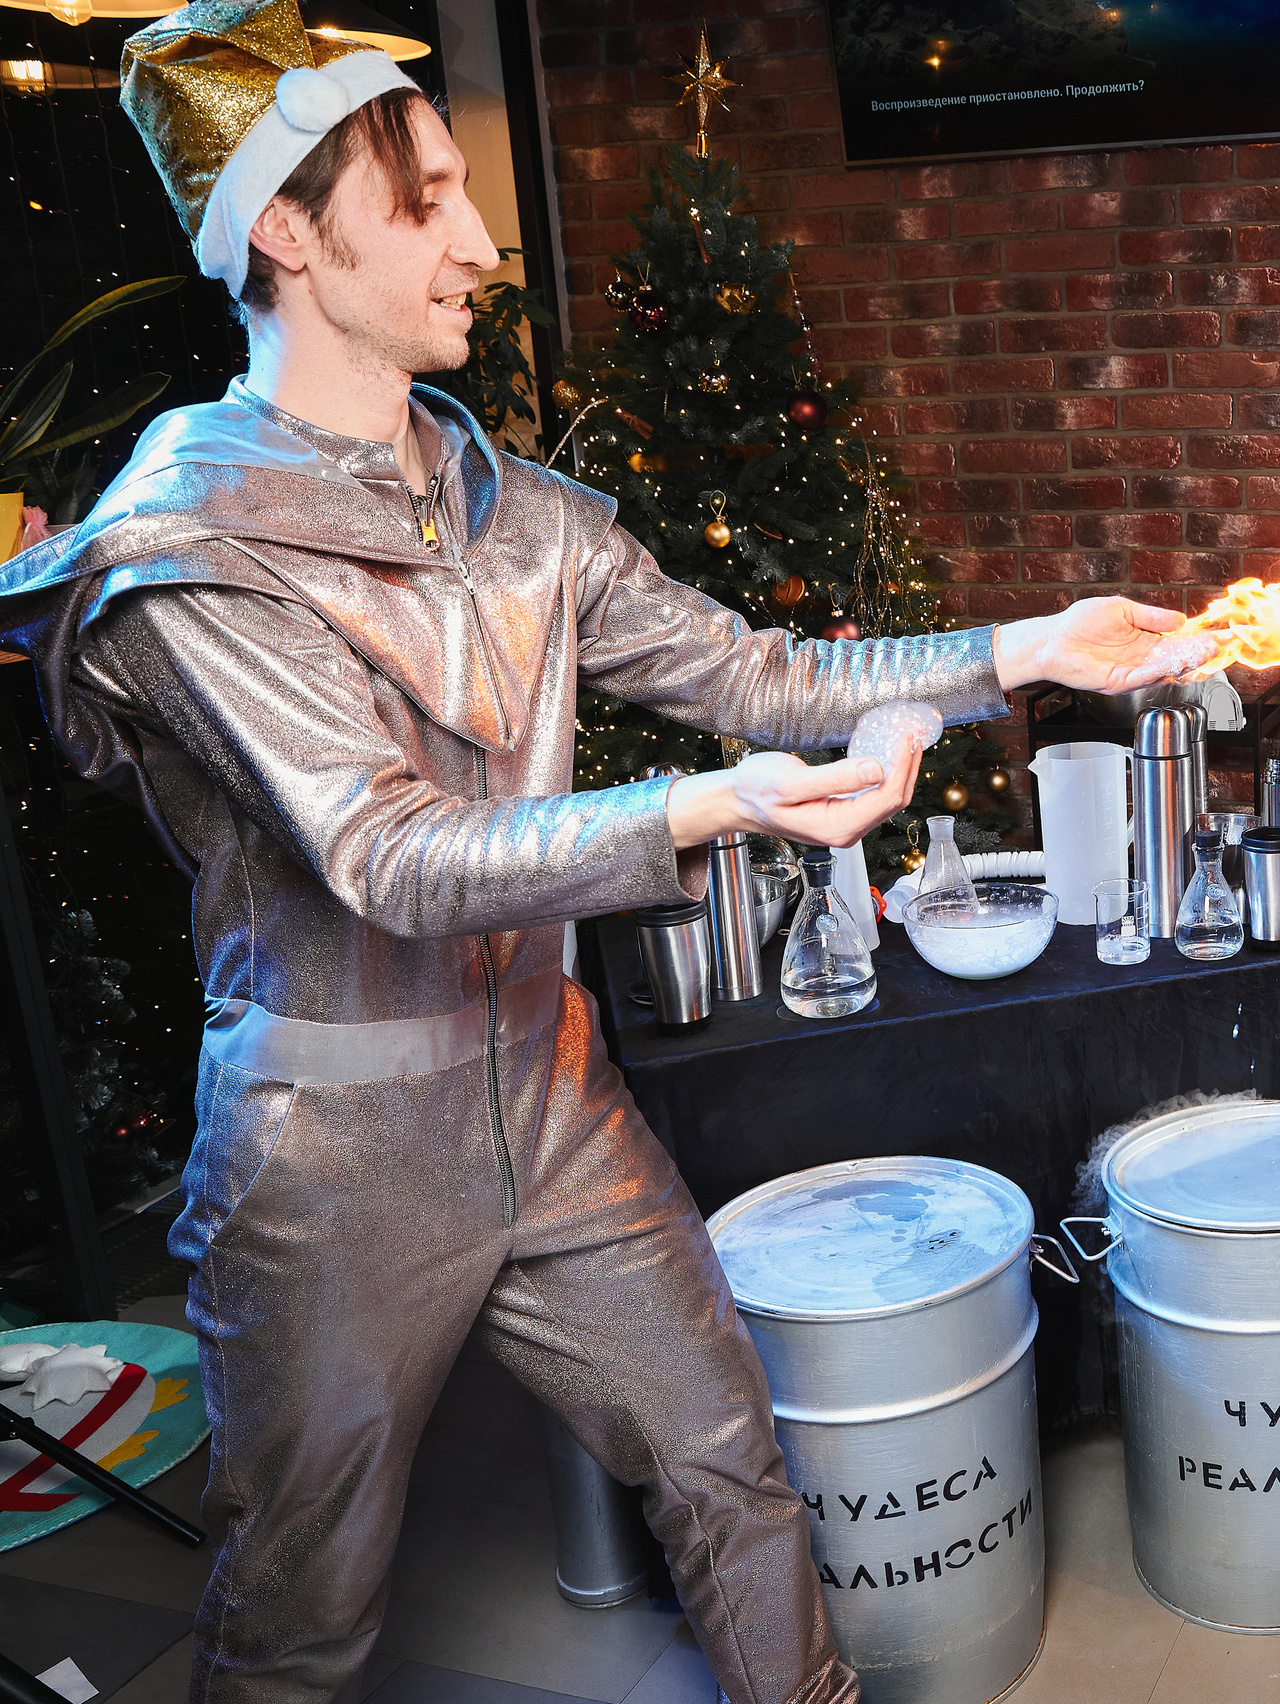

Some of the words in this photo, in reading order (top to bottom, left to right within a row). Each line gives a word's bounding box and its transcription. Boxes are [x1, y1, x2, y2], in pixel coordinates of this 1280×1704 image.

[871, 94, 967, 112] Воспроизведение
[969, 88, 1063, 106] приостановлено.
[1066, 80, 1145, 98] Продолжить?
[802, 1456, 998, 1522] ЧУДЕСА
[820, 1488, 1032, 1590] АЛЬНОСТИ
